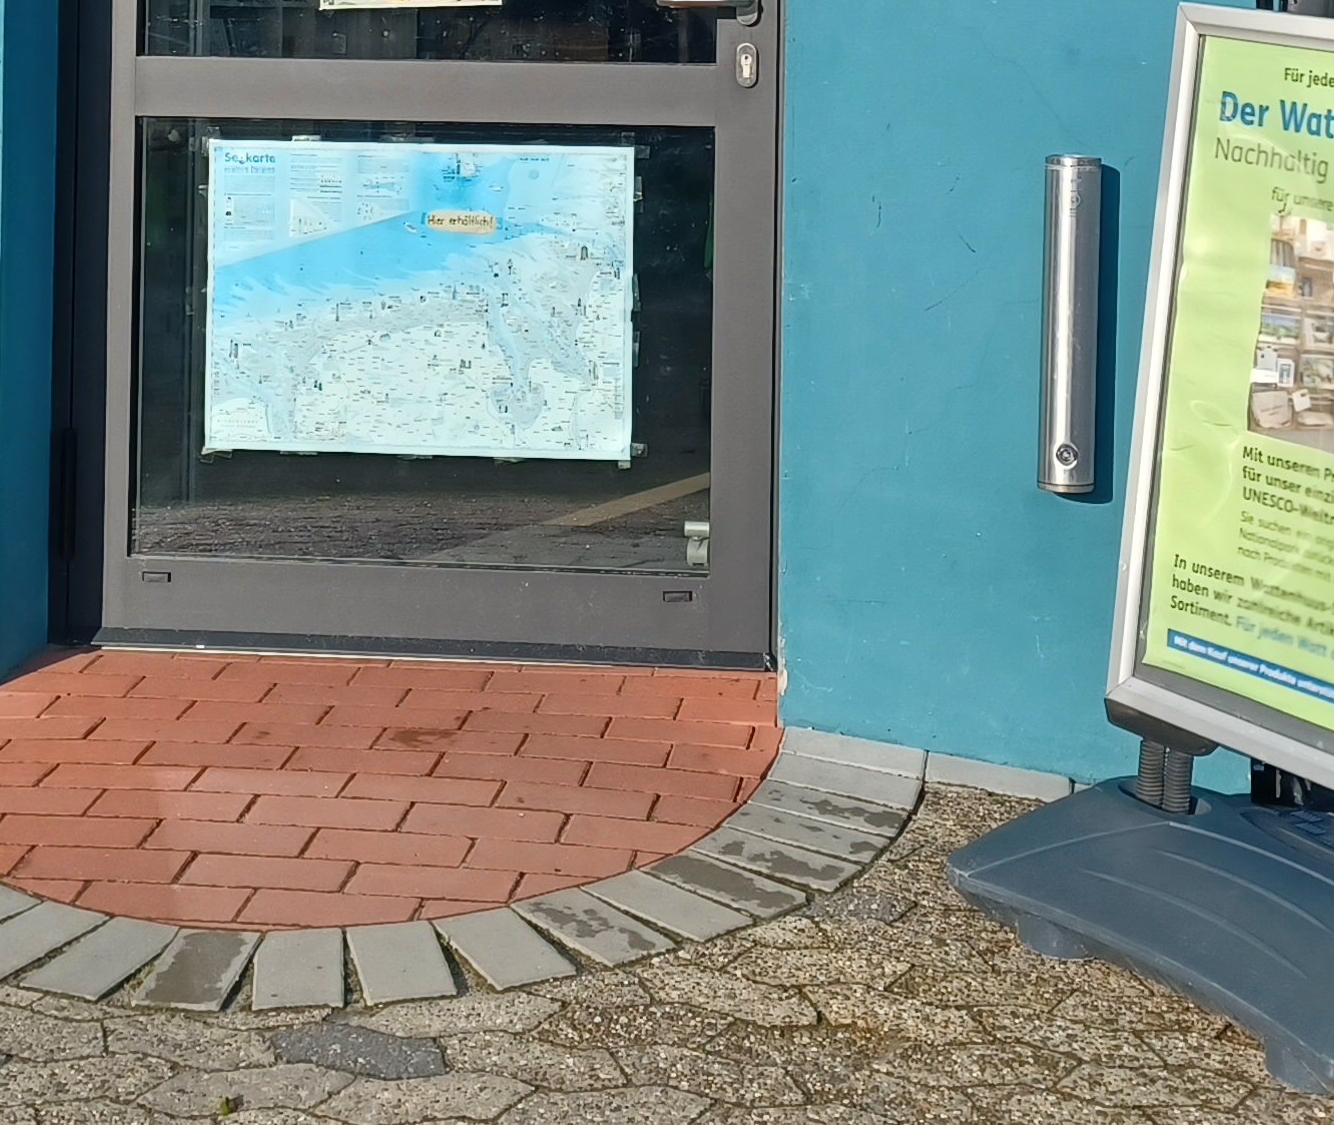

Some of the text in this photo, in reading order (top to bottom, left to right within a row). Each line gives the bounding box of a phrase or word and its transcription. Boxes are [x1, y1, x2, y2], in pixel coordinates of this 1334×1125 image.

[1284, 67, 1304, 82] Für
[1219, 90, 1269, 126] Der
[224, 152, 276, 164] Sekarte
[1215, 137, 1328, 183] Nachhaltig
[1271, 186, 1289, 209] für
[427, 214, 494, 228] Hier erhältlich!
[1242, 445, 1263, 463] Mit
[1266, 455, 1319, 476] unseren
[1242, 465, 1261, 482] für
[1265, 475, 1301, 492] unser
[1173, 553, 1186, 569] In
[1191, 562, 1244, 584] unserem
[1172, 573, 1208, 596] haben
[1213, 590, 1232, 602] wir
[1170, 594, 1230, 625] Sortiment.
